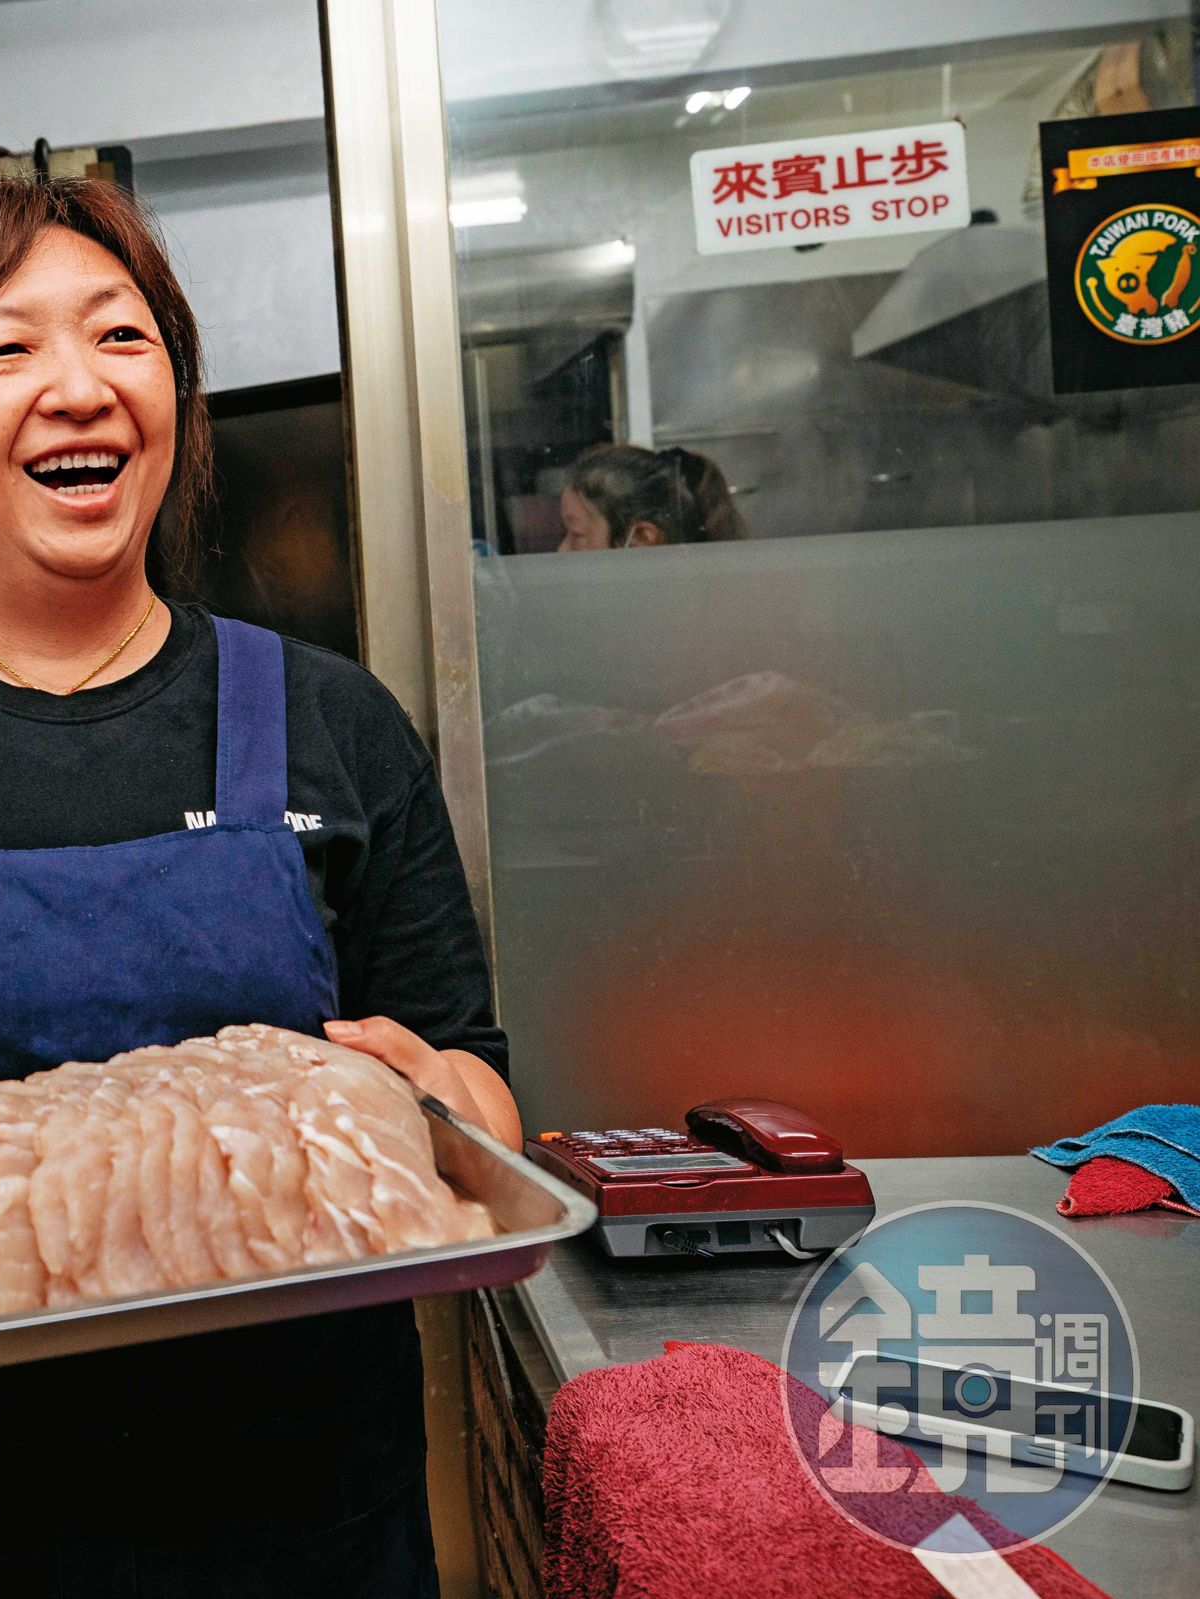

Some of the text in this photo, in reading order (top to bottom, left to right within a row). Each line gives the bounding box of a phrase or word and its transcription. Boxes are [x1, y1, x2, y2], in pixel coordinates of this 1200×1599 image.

[717, 195, 949, 238] VISITORS STOP
[1090, 211, 1200, 257] TAIWAN PORK
